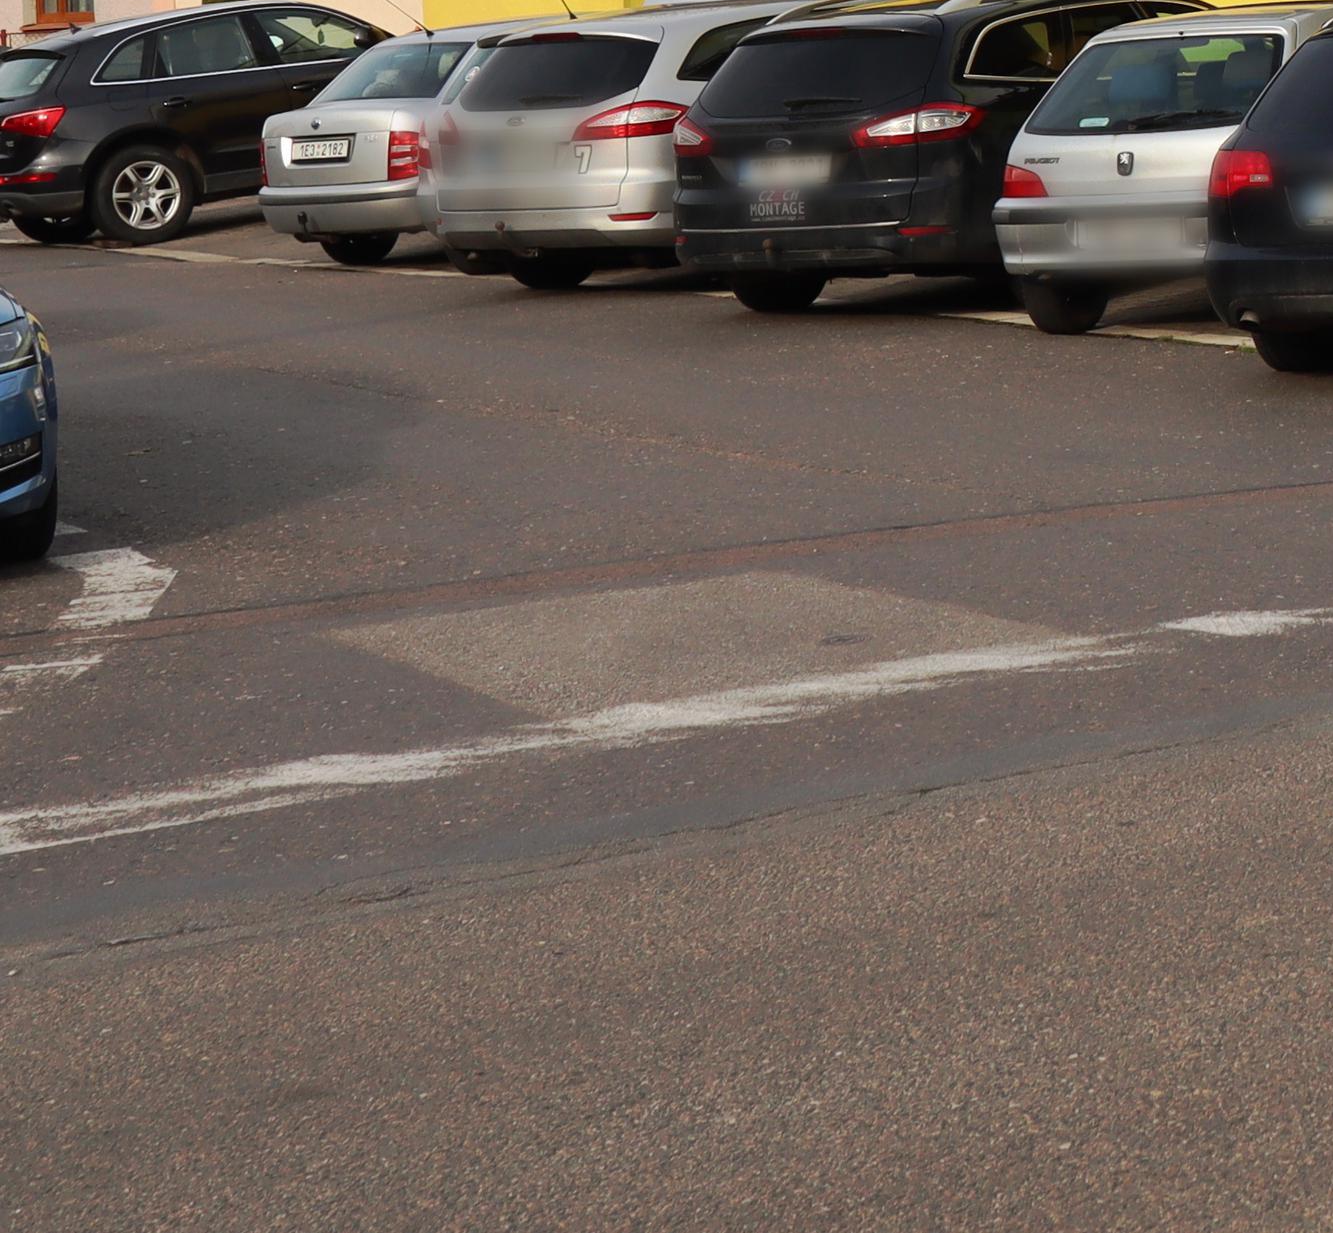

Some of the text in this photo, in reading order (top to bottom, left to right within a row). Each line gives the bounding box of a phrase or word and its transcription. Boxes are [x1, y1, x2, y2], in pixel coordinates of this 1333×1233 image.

[300, 142, 344, 157] 1E3 2182
[574, 144, 592, 174] 7
[750, 201, 806, 216] MONTAGE
